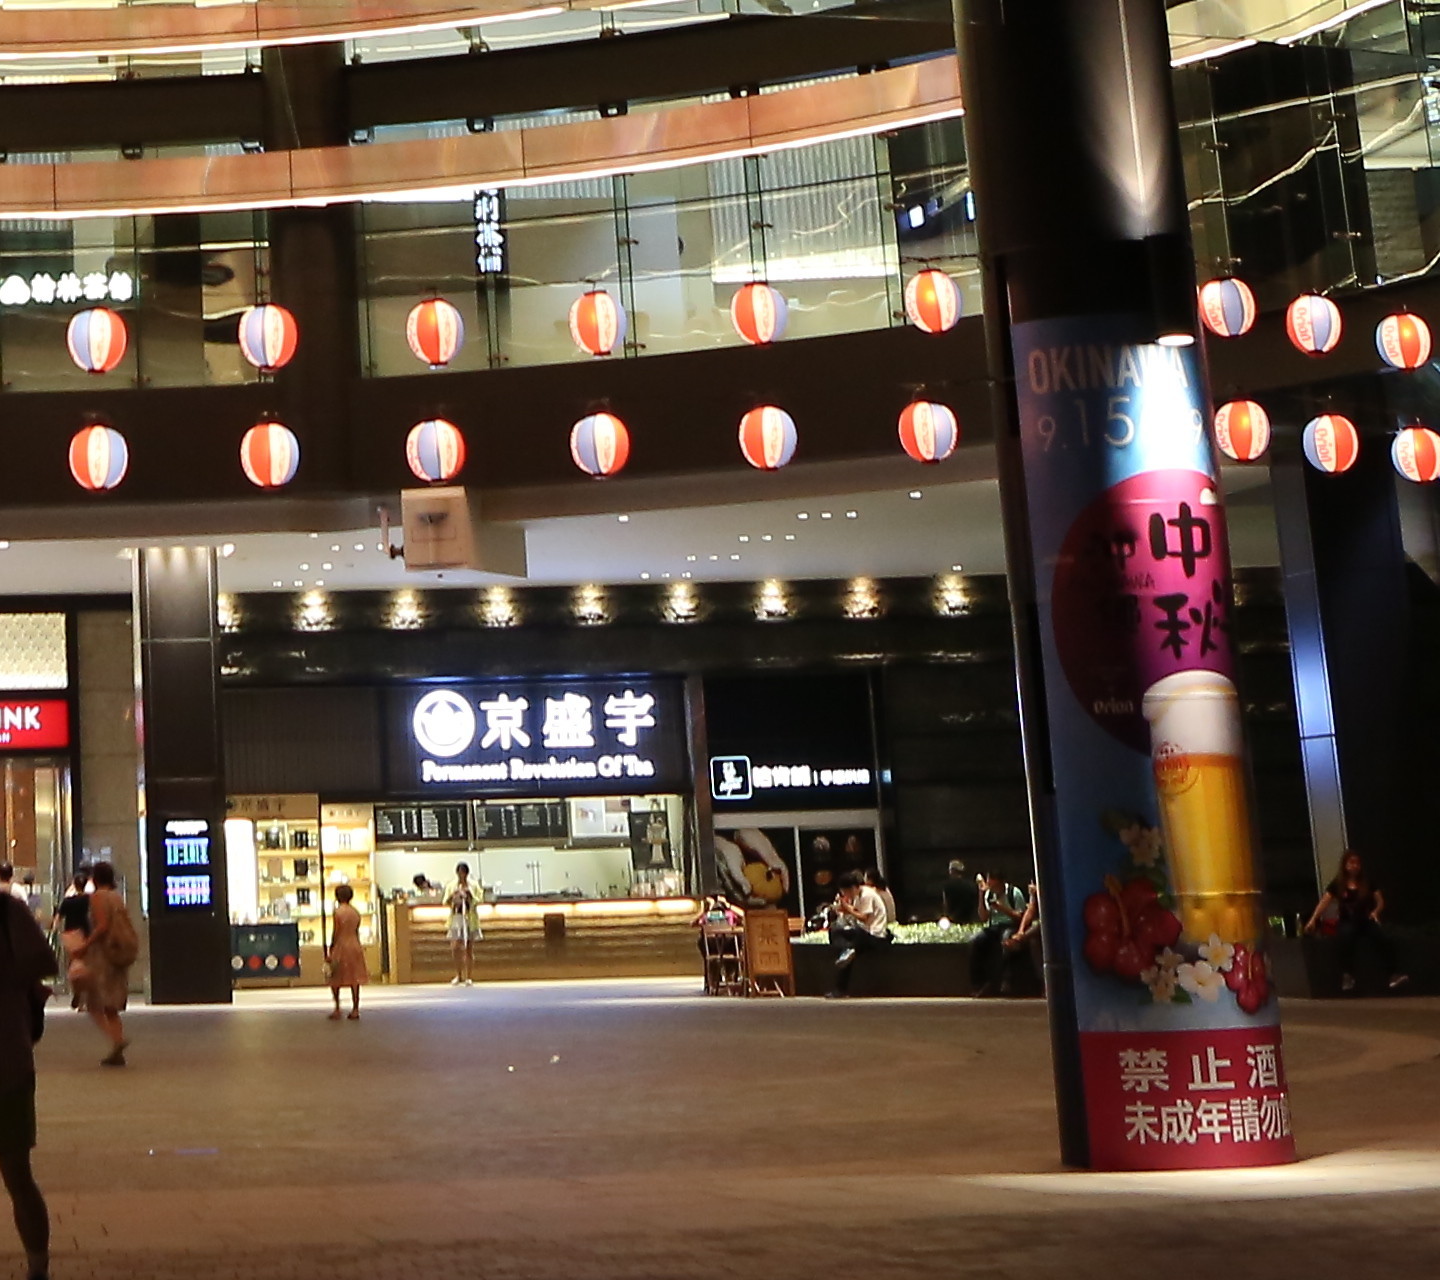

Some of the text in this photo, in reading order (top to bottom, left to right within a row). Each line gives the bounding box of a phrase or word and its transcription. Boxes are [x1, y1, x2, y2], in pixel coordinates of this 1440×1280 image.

[479, 690, 656, 751] 京盛宇
[421, 755, 654, 783] Permanent Revolution Of Tea
[1118, 1043, 1287, 1093] 禁止酒
